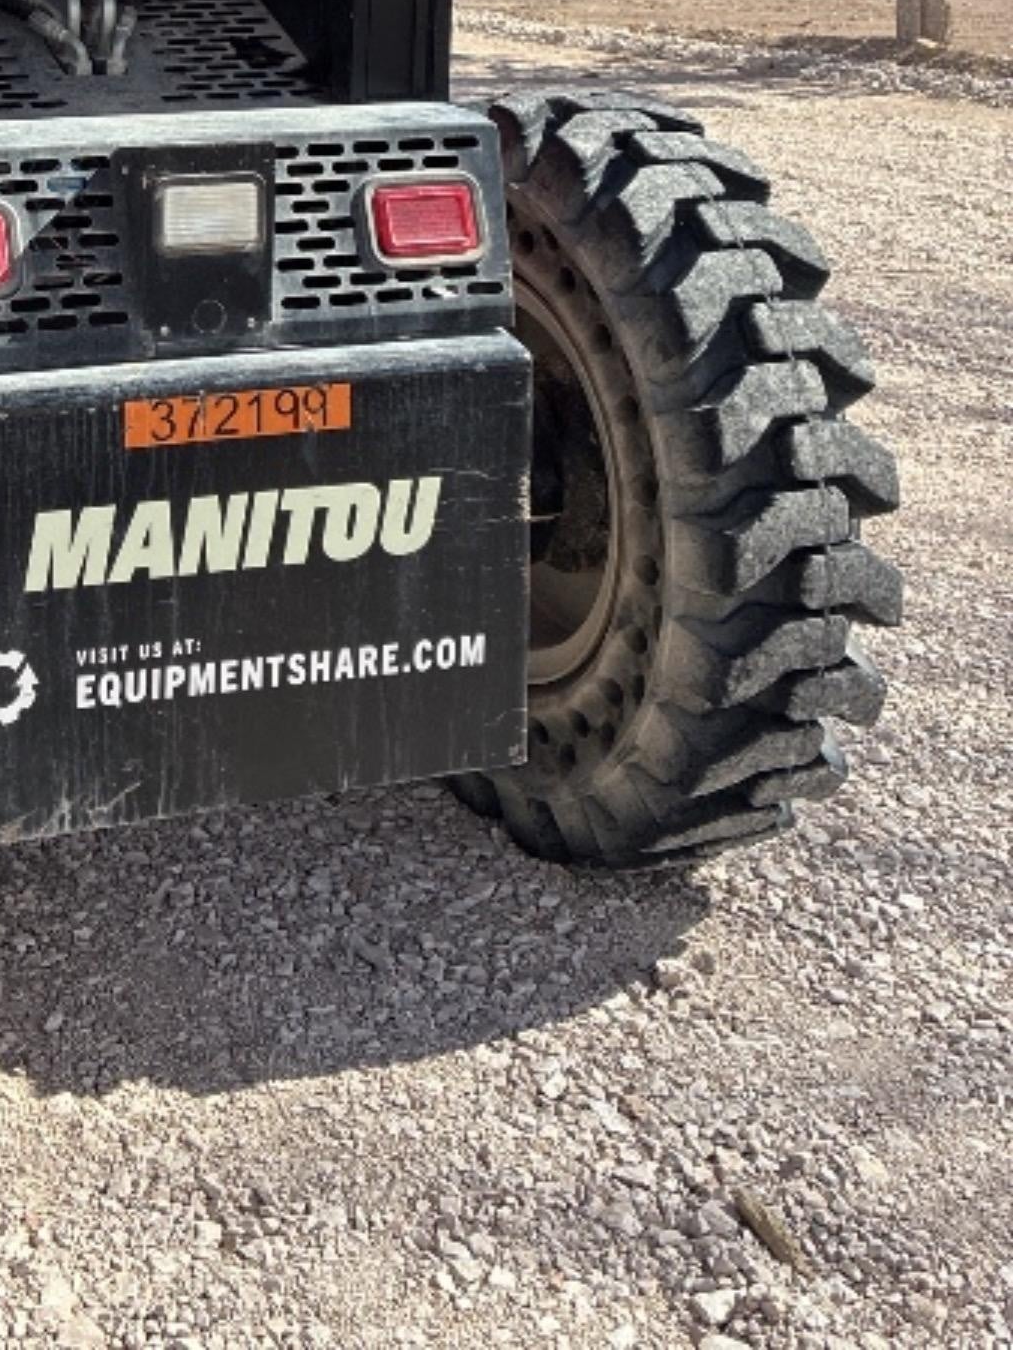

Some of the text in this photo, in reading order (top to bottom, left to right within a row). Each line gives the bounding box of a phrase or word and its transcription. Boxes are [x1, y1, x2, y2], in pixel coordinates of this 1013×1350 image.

[150, 388, 329, 442] 372199
[23, 477, 442, 592] MANITOU
[75, 634, 486, 709] EQUIPMENTSHARE.COM
[76, 638, 202, 665] VISIT US AT:
